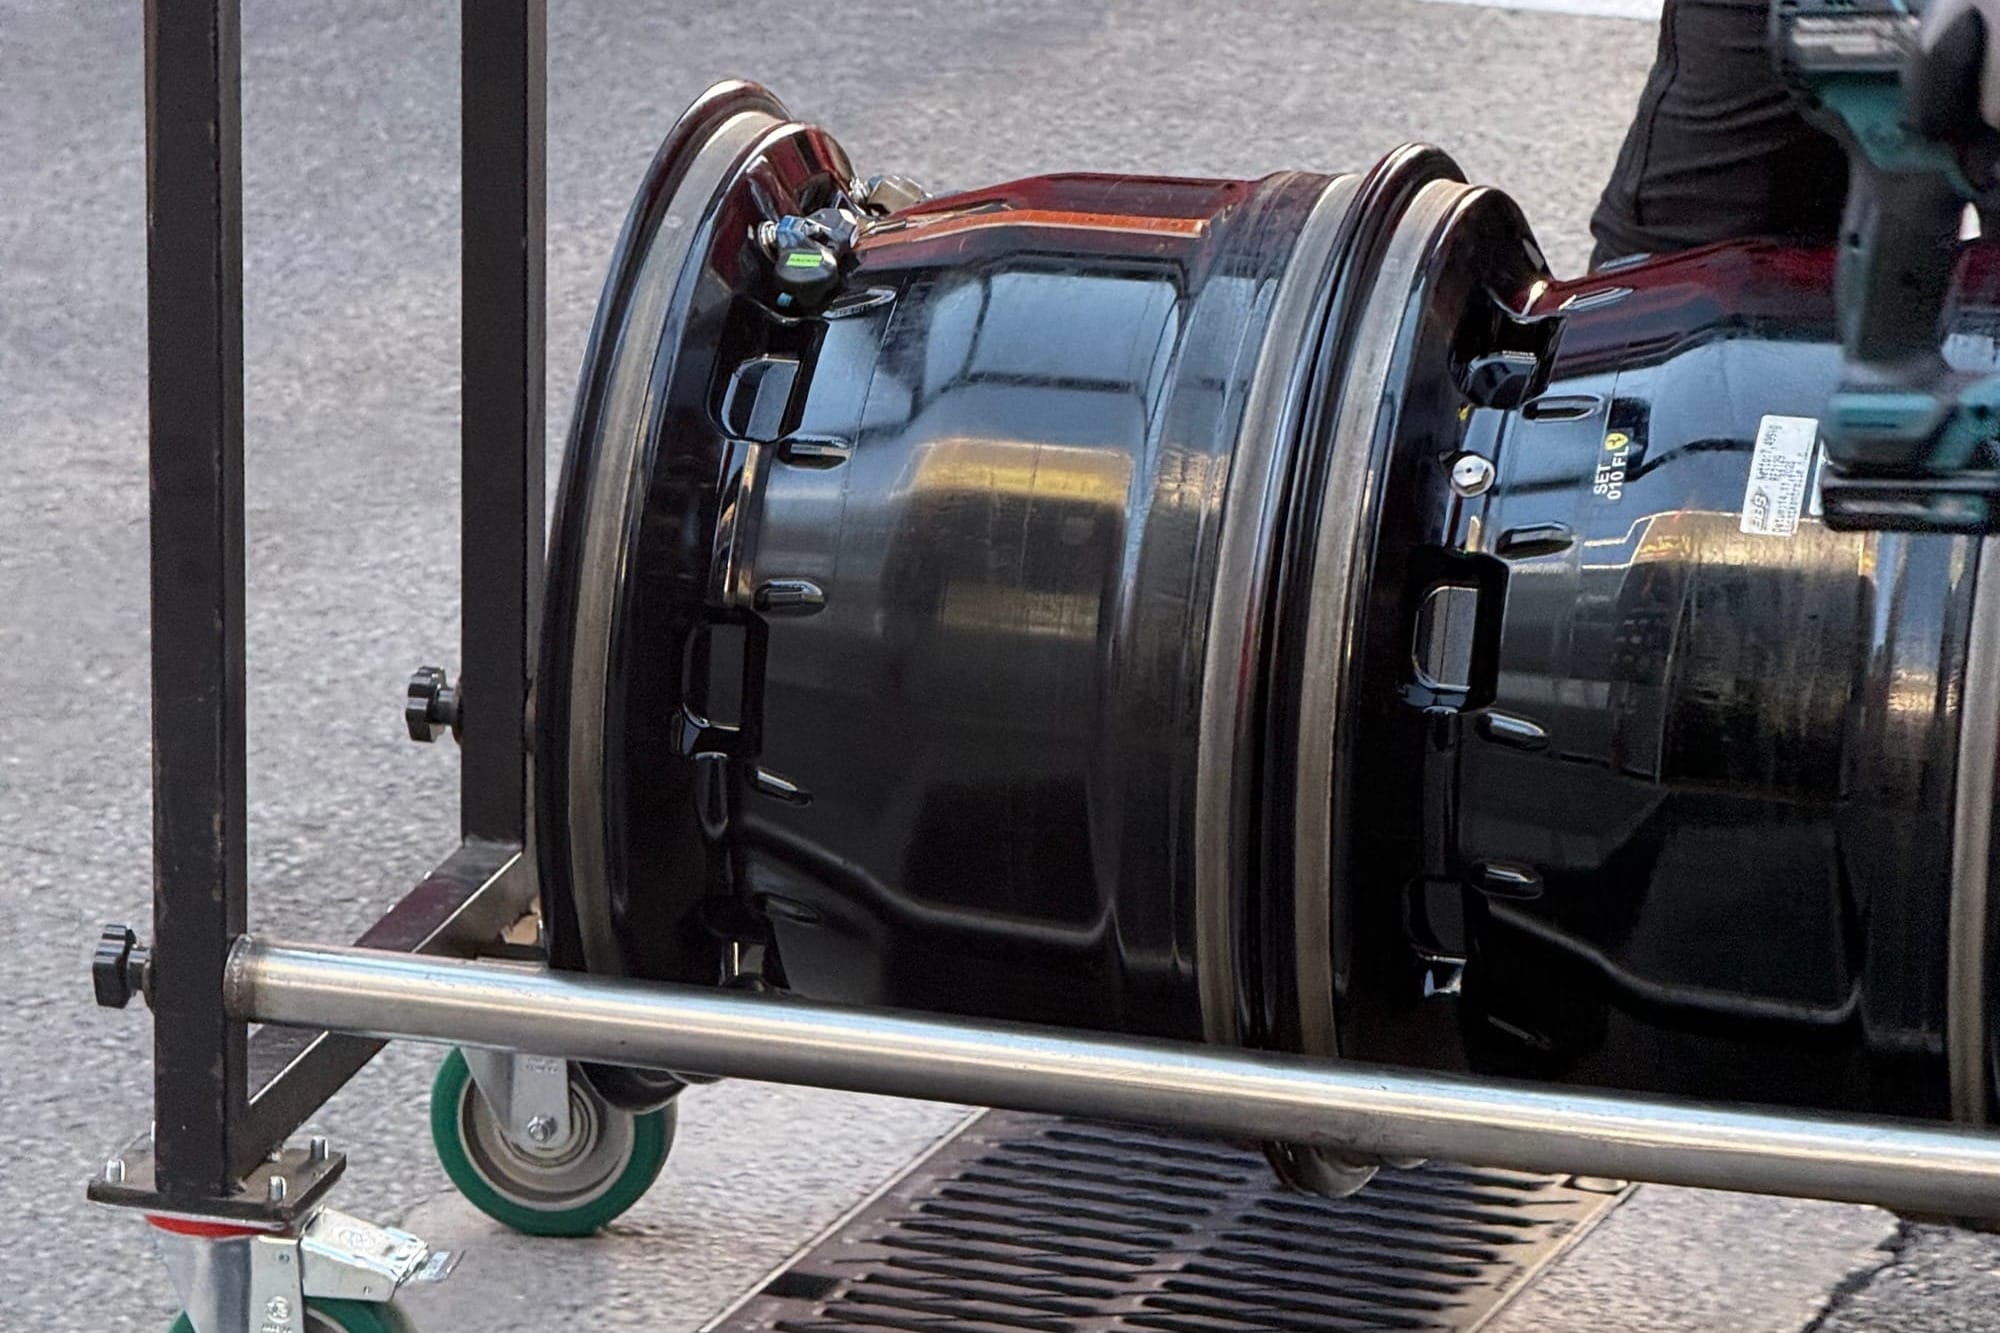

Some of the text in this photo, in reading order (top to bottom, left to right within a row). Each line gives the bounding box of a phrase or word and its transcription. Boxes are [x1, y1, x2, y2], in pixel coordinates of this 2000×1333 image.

[1593, 463, 1611, 495] SET
[1607, 445, 1629, 500] 010 FL
